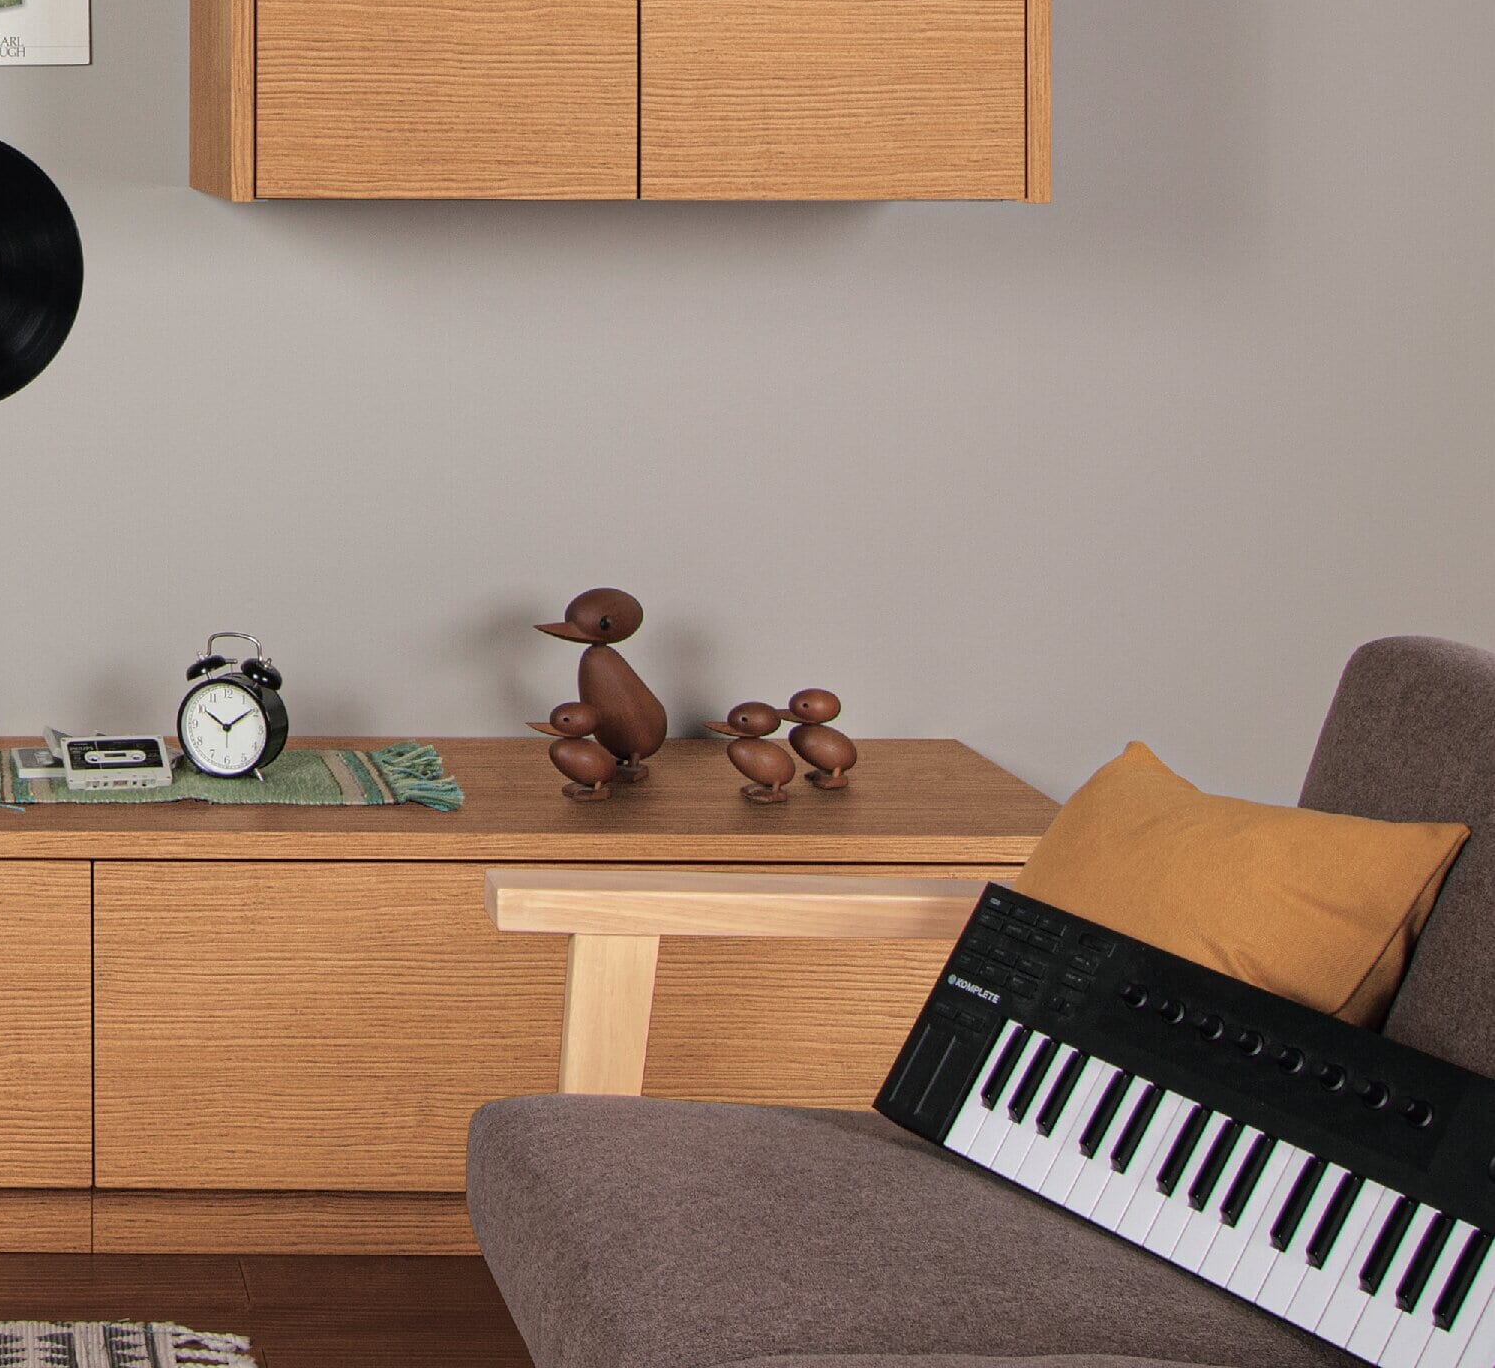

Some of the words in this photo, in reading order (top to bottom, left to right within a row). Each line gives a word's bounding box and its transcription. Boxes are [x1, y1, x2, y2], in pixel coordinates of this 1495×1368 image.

[209, 693, 217, 703] 11
[223, 688, 233, 699] 12
[192, 719, 199, 729] 9
[196, 736, 203, 746] 8
[209, 748, 215, 759] 7
[224, 755, 231, 765] 6
[954, 977, 1001, 1004] KOMPLETE
